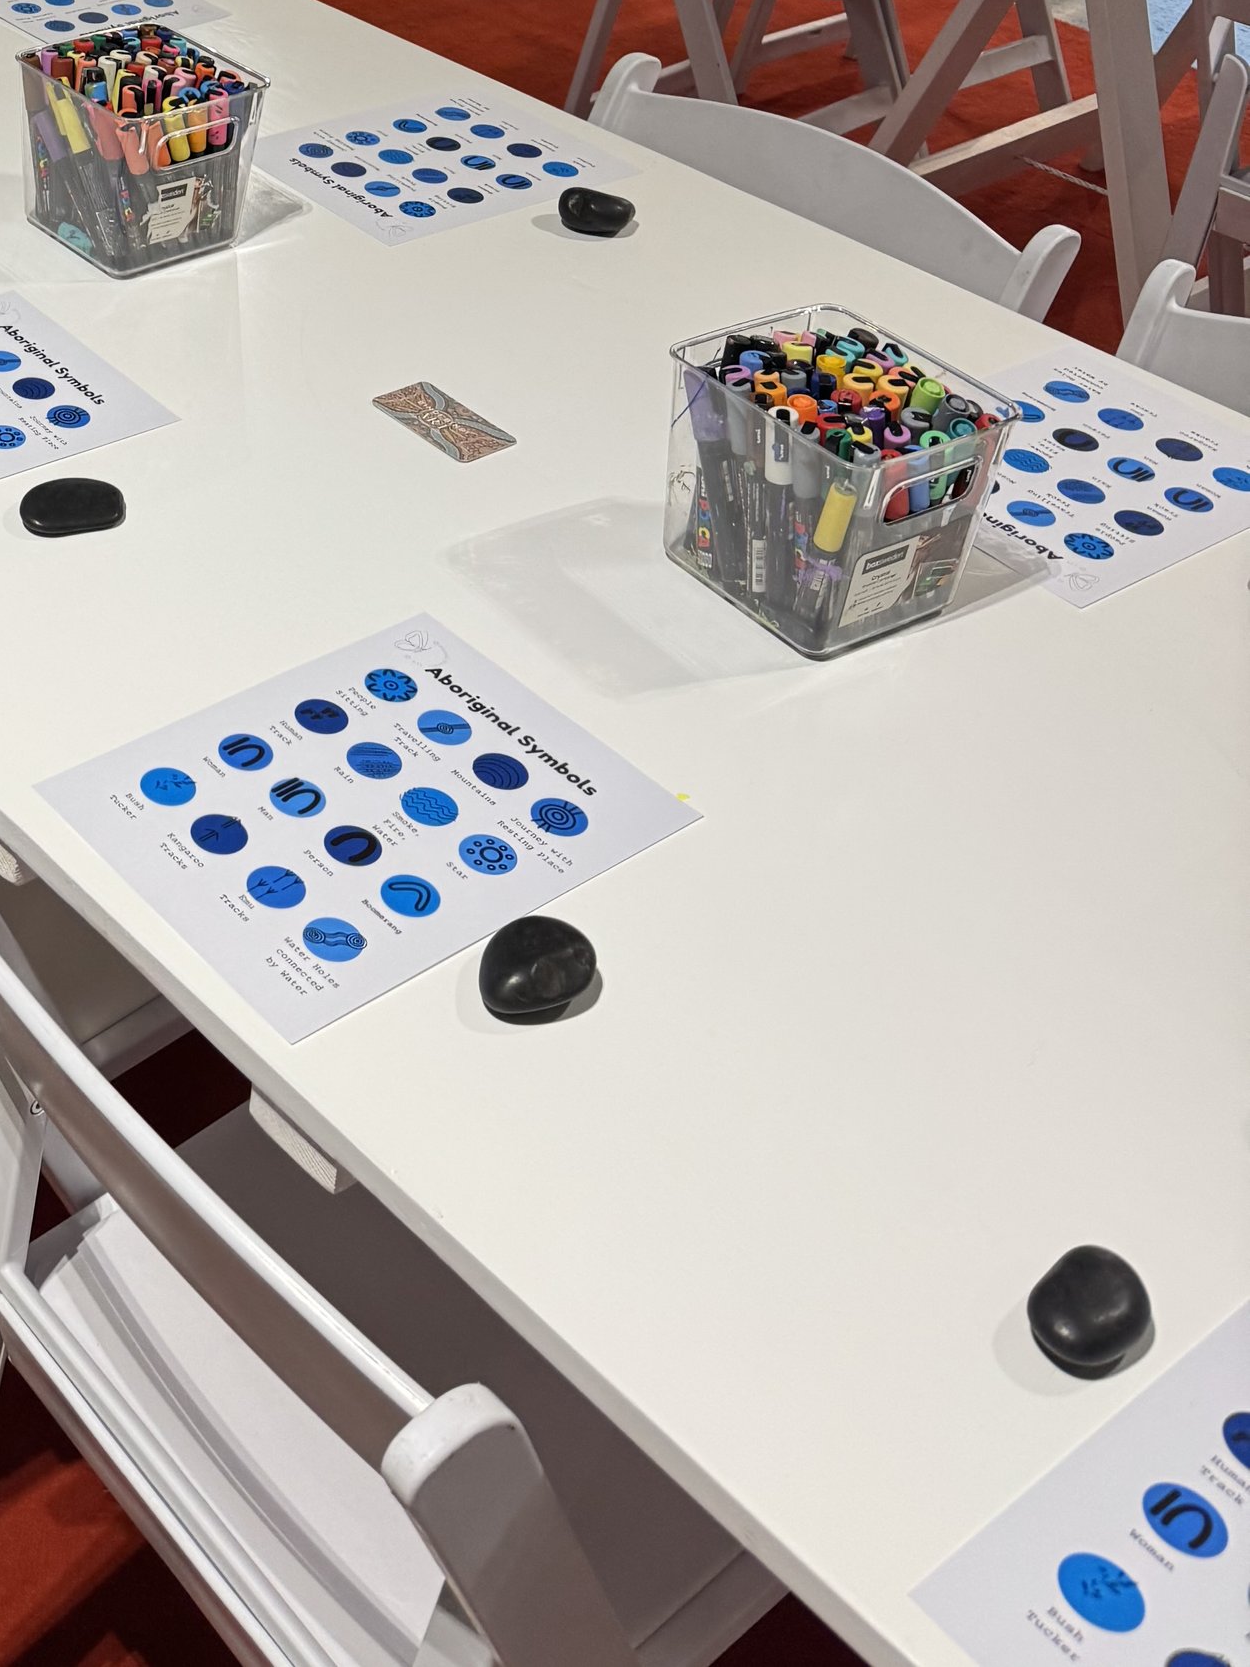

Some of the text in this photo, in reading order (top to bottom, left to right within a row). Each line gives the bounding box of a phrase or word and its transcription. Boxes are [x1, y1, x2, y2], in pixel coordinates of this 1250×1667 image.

[55, 366, 106, 406] Symbols
[983, 512, 1064, 560] Aborigin
[335, 688, 369, 718] Sitting
[348, 686, 377, 711] People
[268, 724, 293, 747] Track
[279, 719, 304, 742] Human
[393, 722, 441, 763] Travelling
[425, 666, 599, 797] Aboriginal Symbols
[394, 735, 420, 759] Track
[202, 755, 227, 779] Woman
[333, 765, 355, 785] Rain
[450, 768, 497, 806] Mountains
[109, 794, 138, 821] Tucker
[257, 805, 275, 822] Man
[371, 823, 398, 847] Water
[382, 818, 406, 841] Fire,
[496, 820, 535, 851] Resting
[510, 817, 573, 867] Journey with
[159, 841, 188, 872] Tracks
[167, 831, 205, 869] Kangaroo
[303, 848, 334, 878] Person
[445, 860, 469, 880] Star
[219, 893, 250, 923] Tracks
[361, 898, 403, 936] Boomerang
[264, 955, 309, 997] by Water
[275, 946, 325, 992] connected
[283, 935, 341, 989] Water Holes
[1200, 1465, 1243, 1506] Track
[1129, 1527, 1175, 1572] Woman
[1026, 1609, 1081, 1663] Tucker
[1047, 1605, 1085, 1644] Bush
